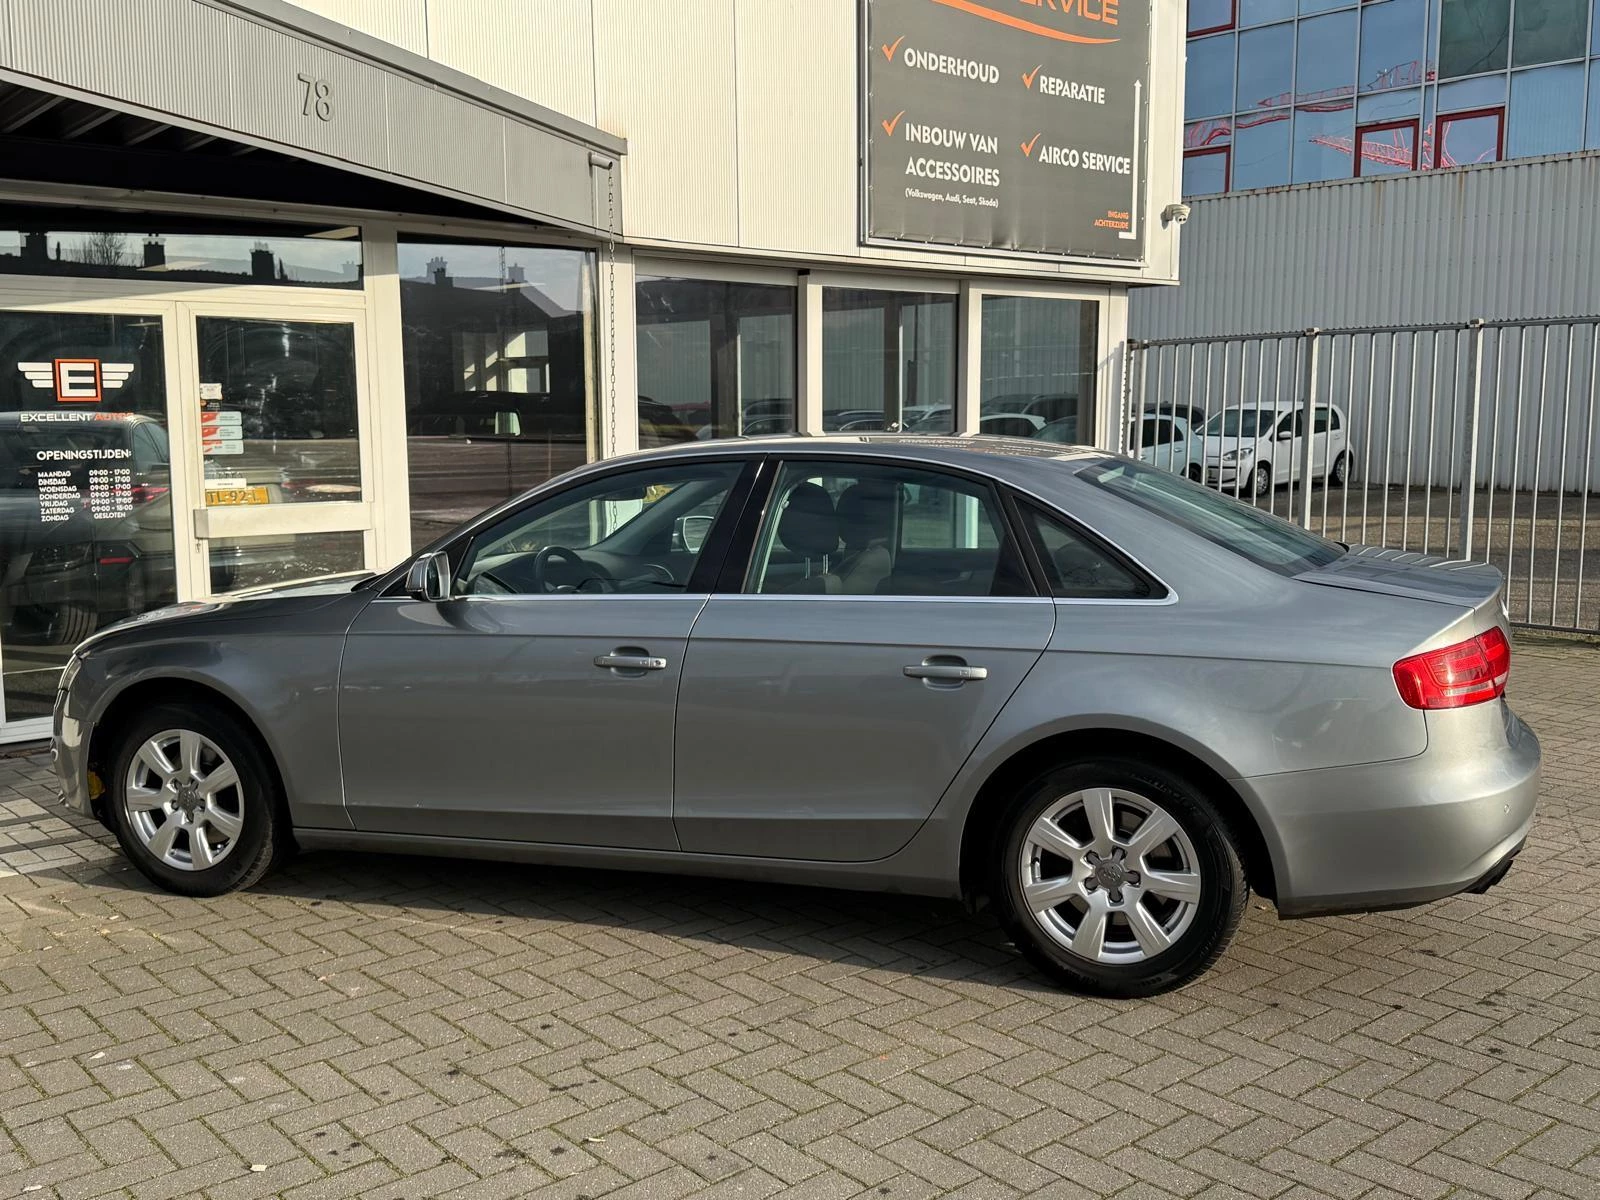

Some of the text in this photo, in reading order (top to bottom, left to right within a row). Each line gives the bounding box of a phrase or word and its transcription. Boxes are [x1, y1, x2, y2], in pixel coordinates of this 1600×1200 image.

[904, 48, 1000, 84] ONDERHOUD
[297, 73, 336, 122] 78
[1040, 75, 1105, 105] REPARATIE
[905, 122, 998, 155] INBOUW VAN
[905, 156, 1000, 187] ACCESSOIRES
[1039, 145, 1131, 175] AIRCO SERVICE
[60, 362, 97, 397] E
[20, 413, 92, 422] EXCELLENT
[36, 449, 132, 460] OPENINGSTIJDEN:
[37, 470, 71, 478] MAANDAG
[38, 478, 67, 486] DINSDAG
[39, 485, 77, 493] WOENSDAG
[41, 511, 126, 522] ZONDAG GESLOTEN
